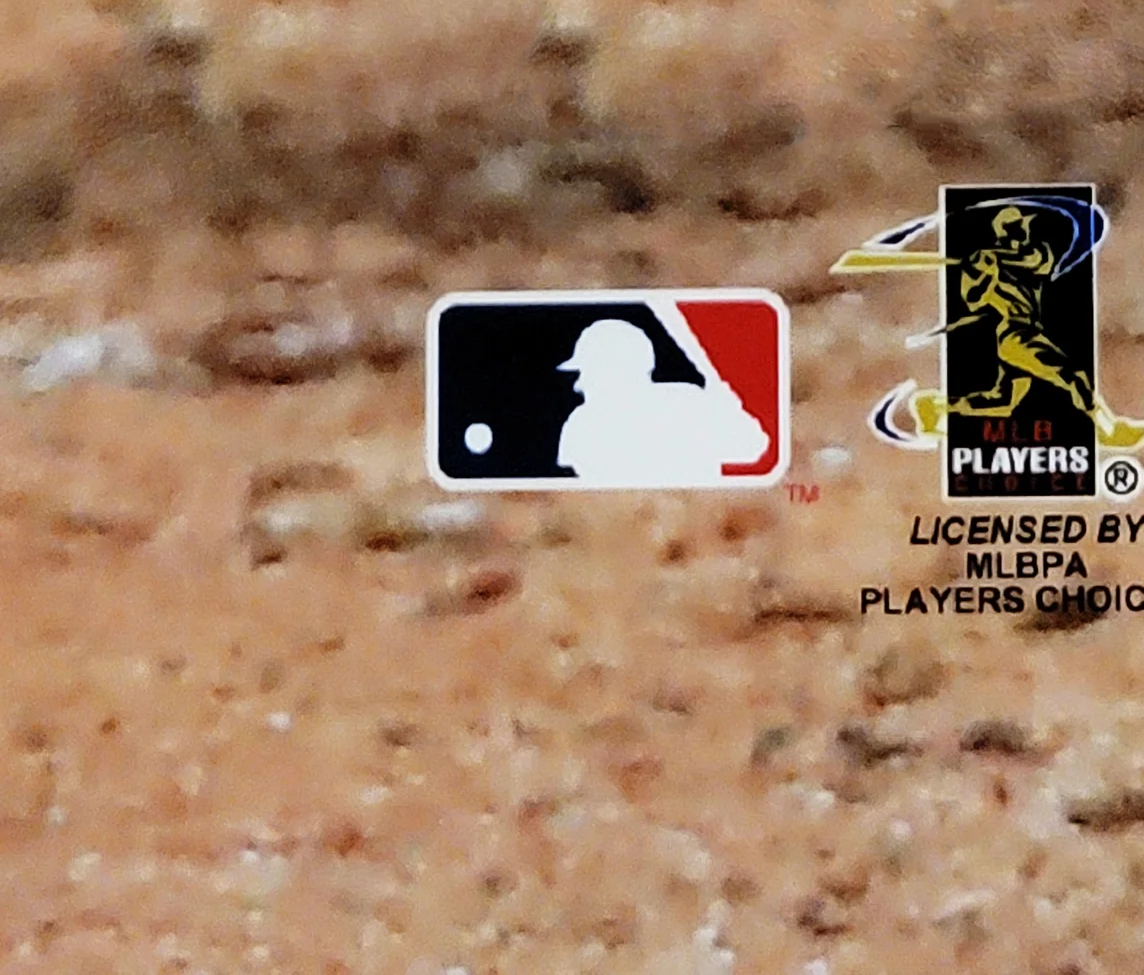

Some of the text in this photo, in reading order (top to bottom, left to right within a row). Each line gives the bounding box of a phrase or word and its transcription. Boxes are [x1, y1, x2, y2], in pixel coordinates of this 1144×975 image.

[982, 419, 1053, 443] MLB
[951, 446, 1090, 474] PLAYERS
[909, 514, 1088, 545] LICENSED
[965, 551, 1088, 580] MLBPA
[860, 585, 1026, 615] PLAYERS
